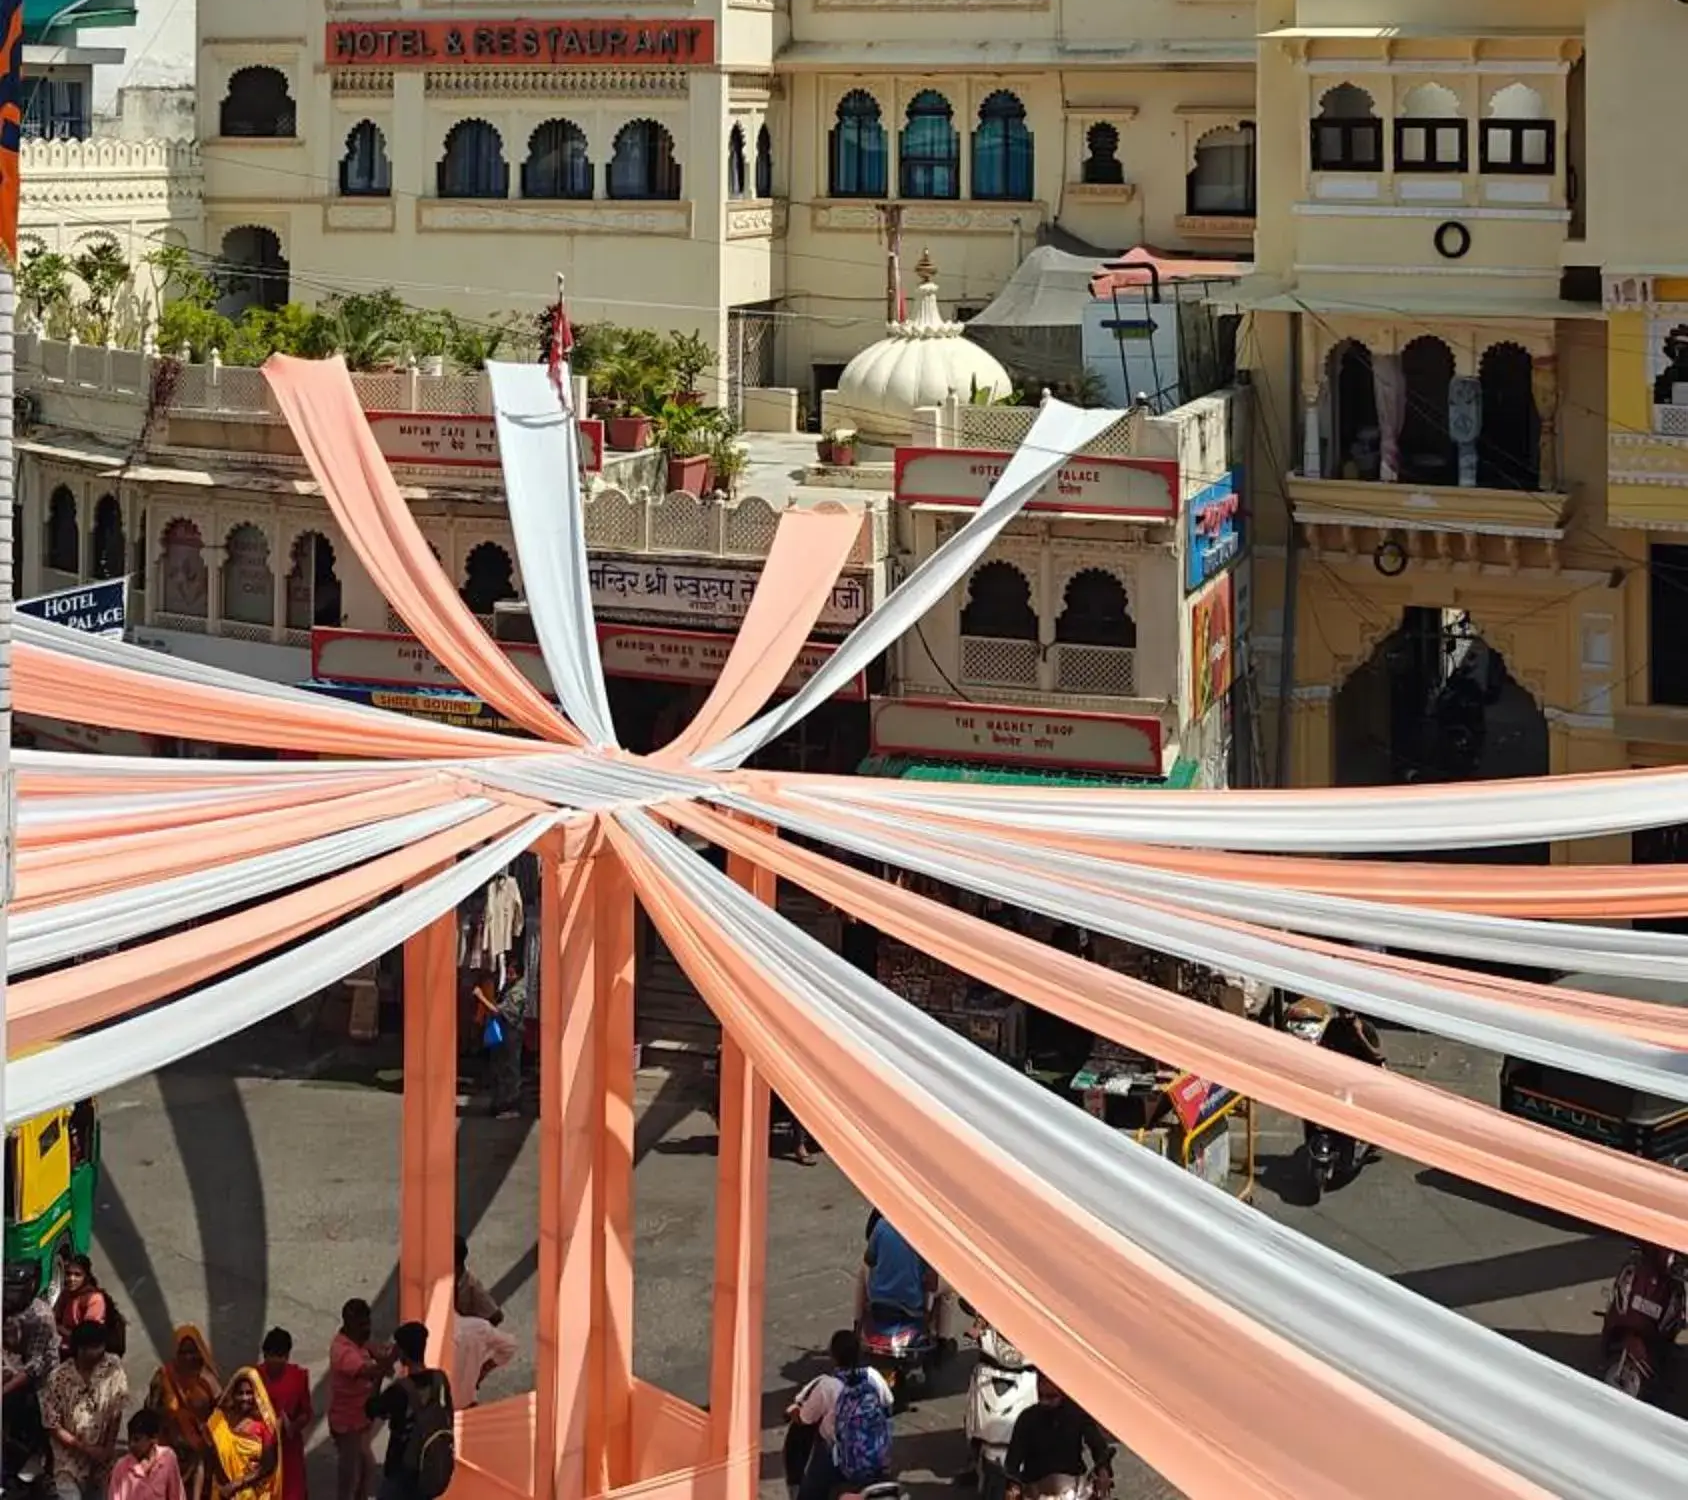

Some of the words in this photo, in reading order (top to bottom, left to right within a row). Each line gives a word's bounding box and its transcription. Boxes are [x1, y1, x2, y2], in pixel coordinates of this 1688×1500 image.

[335, 29, 436, 57] HOTEL
[444, 29, 466, 56] &
[473, 28, 702, 58] RESTAURANT
[970, 465, 1002, 477] HOTE
[1057, 470, 1101, 483] PALACE
[645, 567, 667, 596] श्री
[45, 592, 97, 618] HOTEL
[68, 607, 123, 629] PALACE
[380, 694, 419, 709] SHREE
[423, 699, 471, 713] GOVIND
[955, 717, 975, 729] THE
[986, 720, 1033, 733] MAGNET
[1045, 723, 1074, 736] SHOP
